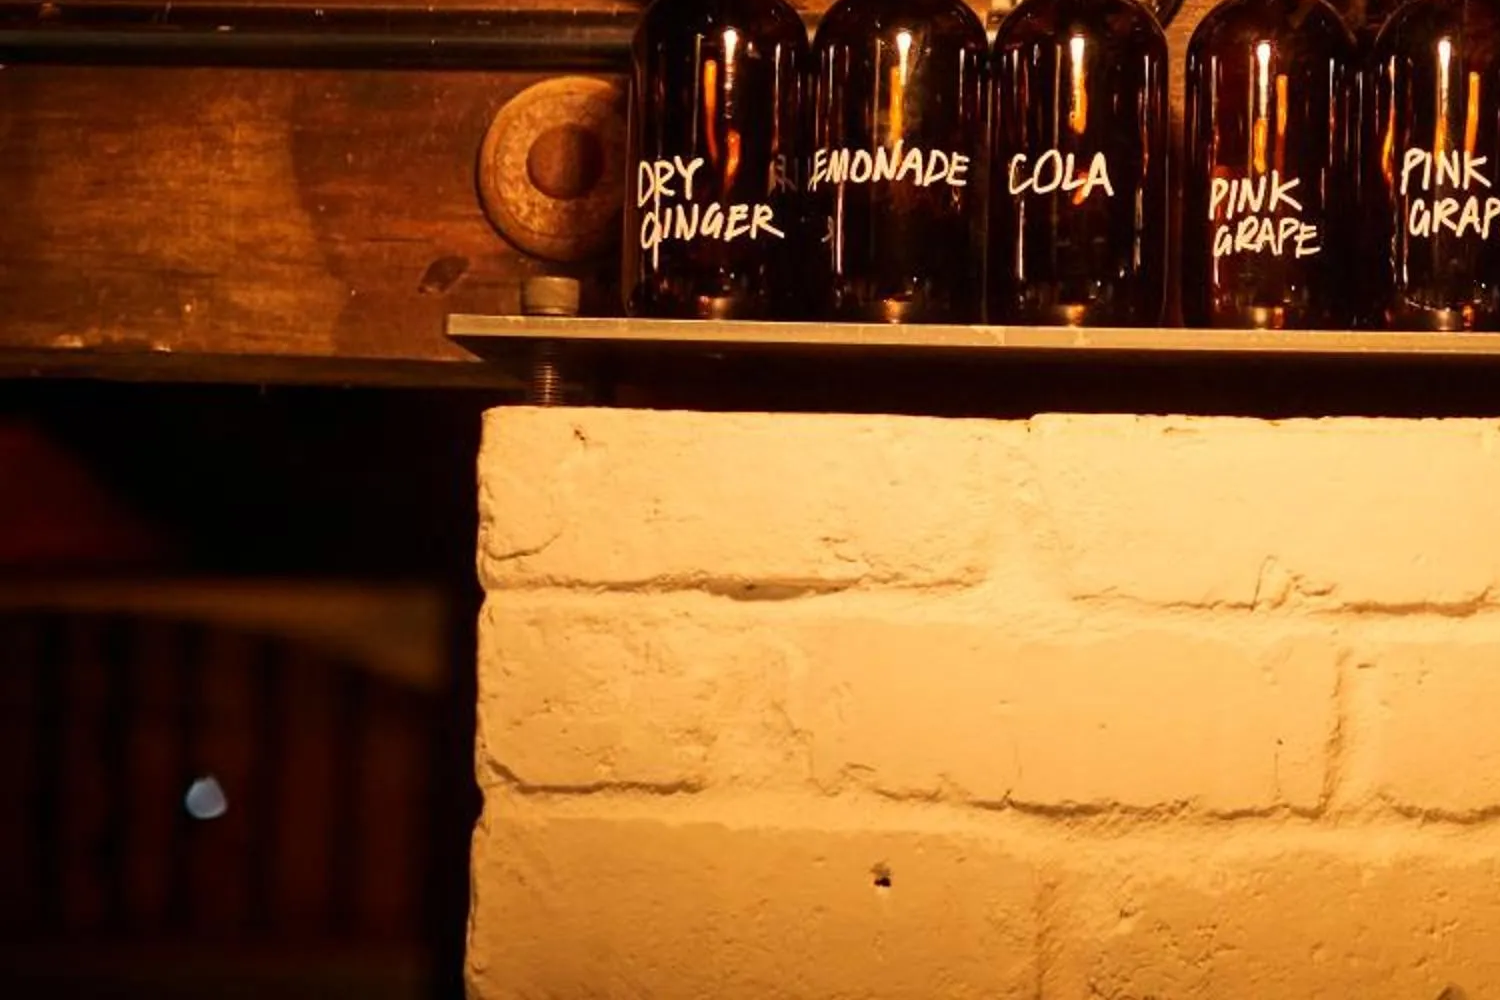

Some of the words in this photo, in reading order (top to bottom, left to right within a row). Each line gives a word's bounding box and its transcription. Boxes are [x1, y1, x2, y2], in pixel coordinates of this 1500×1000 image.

[637, 154, 705, 209] DRY
[1008, 148, 1115, 197] COLA
[1401, 147, 1492, 193] PINK
[1208, 169, 1304, 222] PINK
[640, 201, 786, 251] GINGER
[1213, 216, 1321, 259] GRAPE
